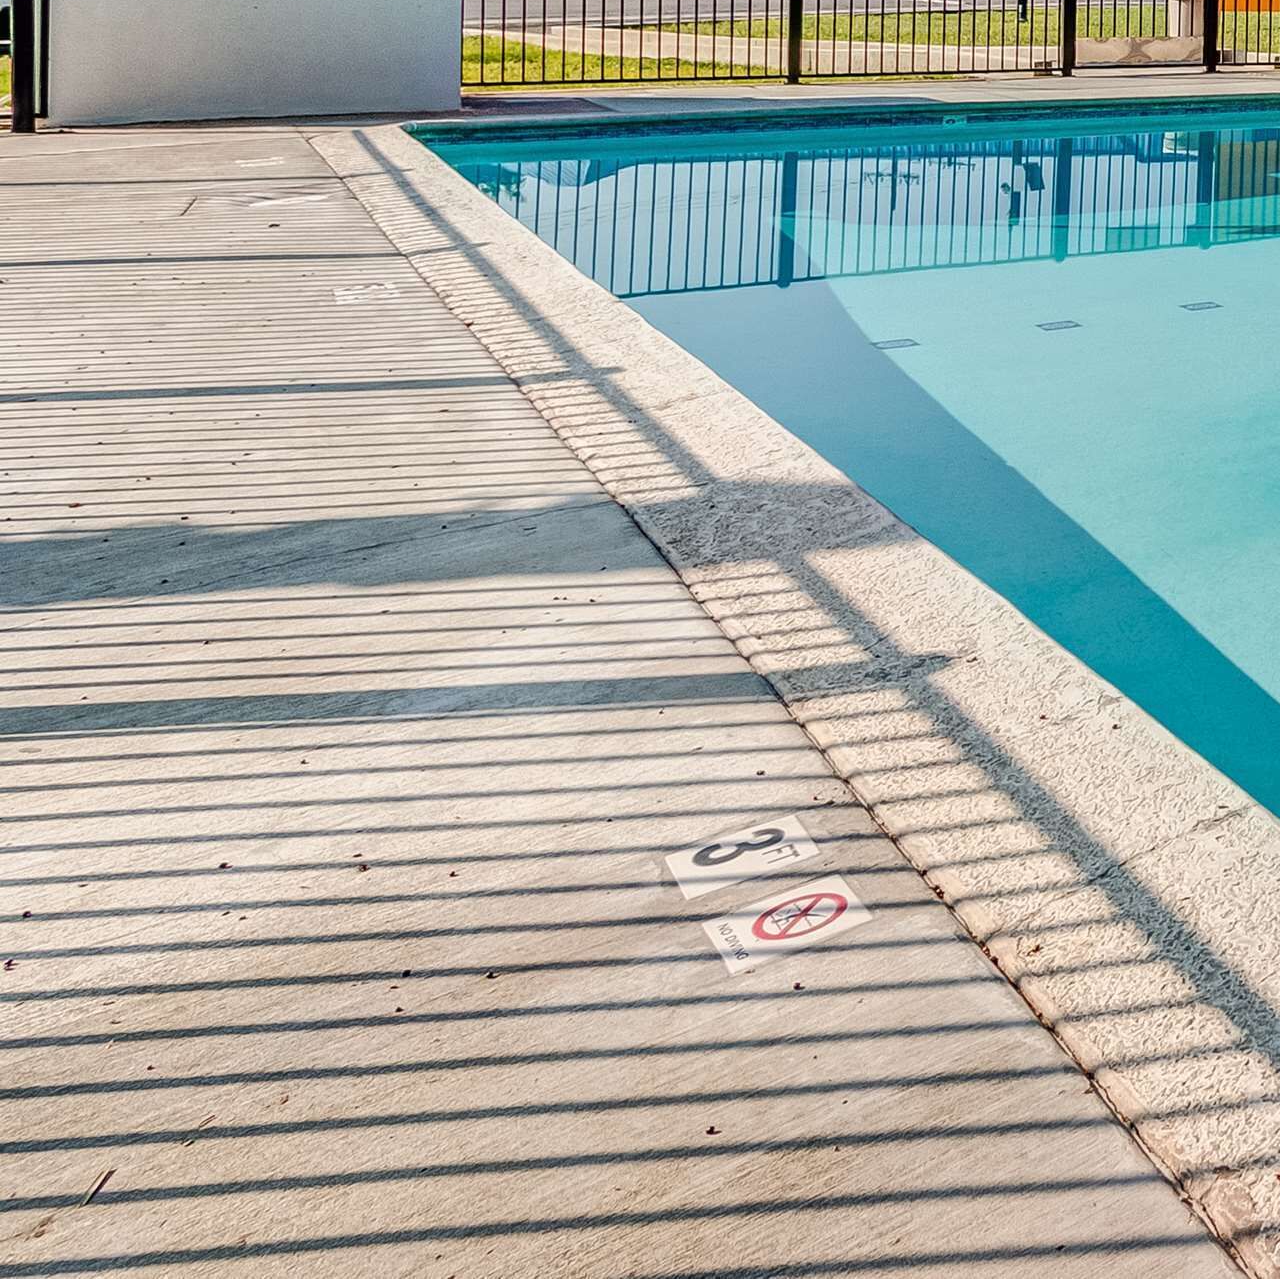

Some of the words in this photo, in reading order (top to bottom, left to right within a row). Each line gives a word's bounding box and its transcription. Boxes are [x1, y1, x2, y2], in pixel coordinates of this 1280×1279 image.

[692, 828, 786, 867] 3
[761, 843, 801, 865] FT
[718, 922, 734, 936] NO
